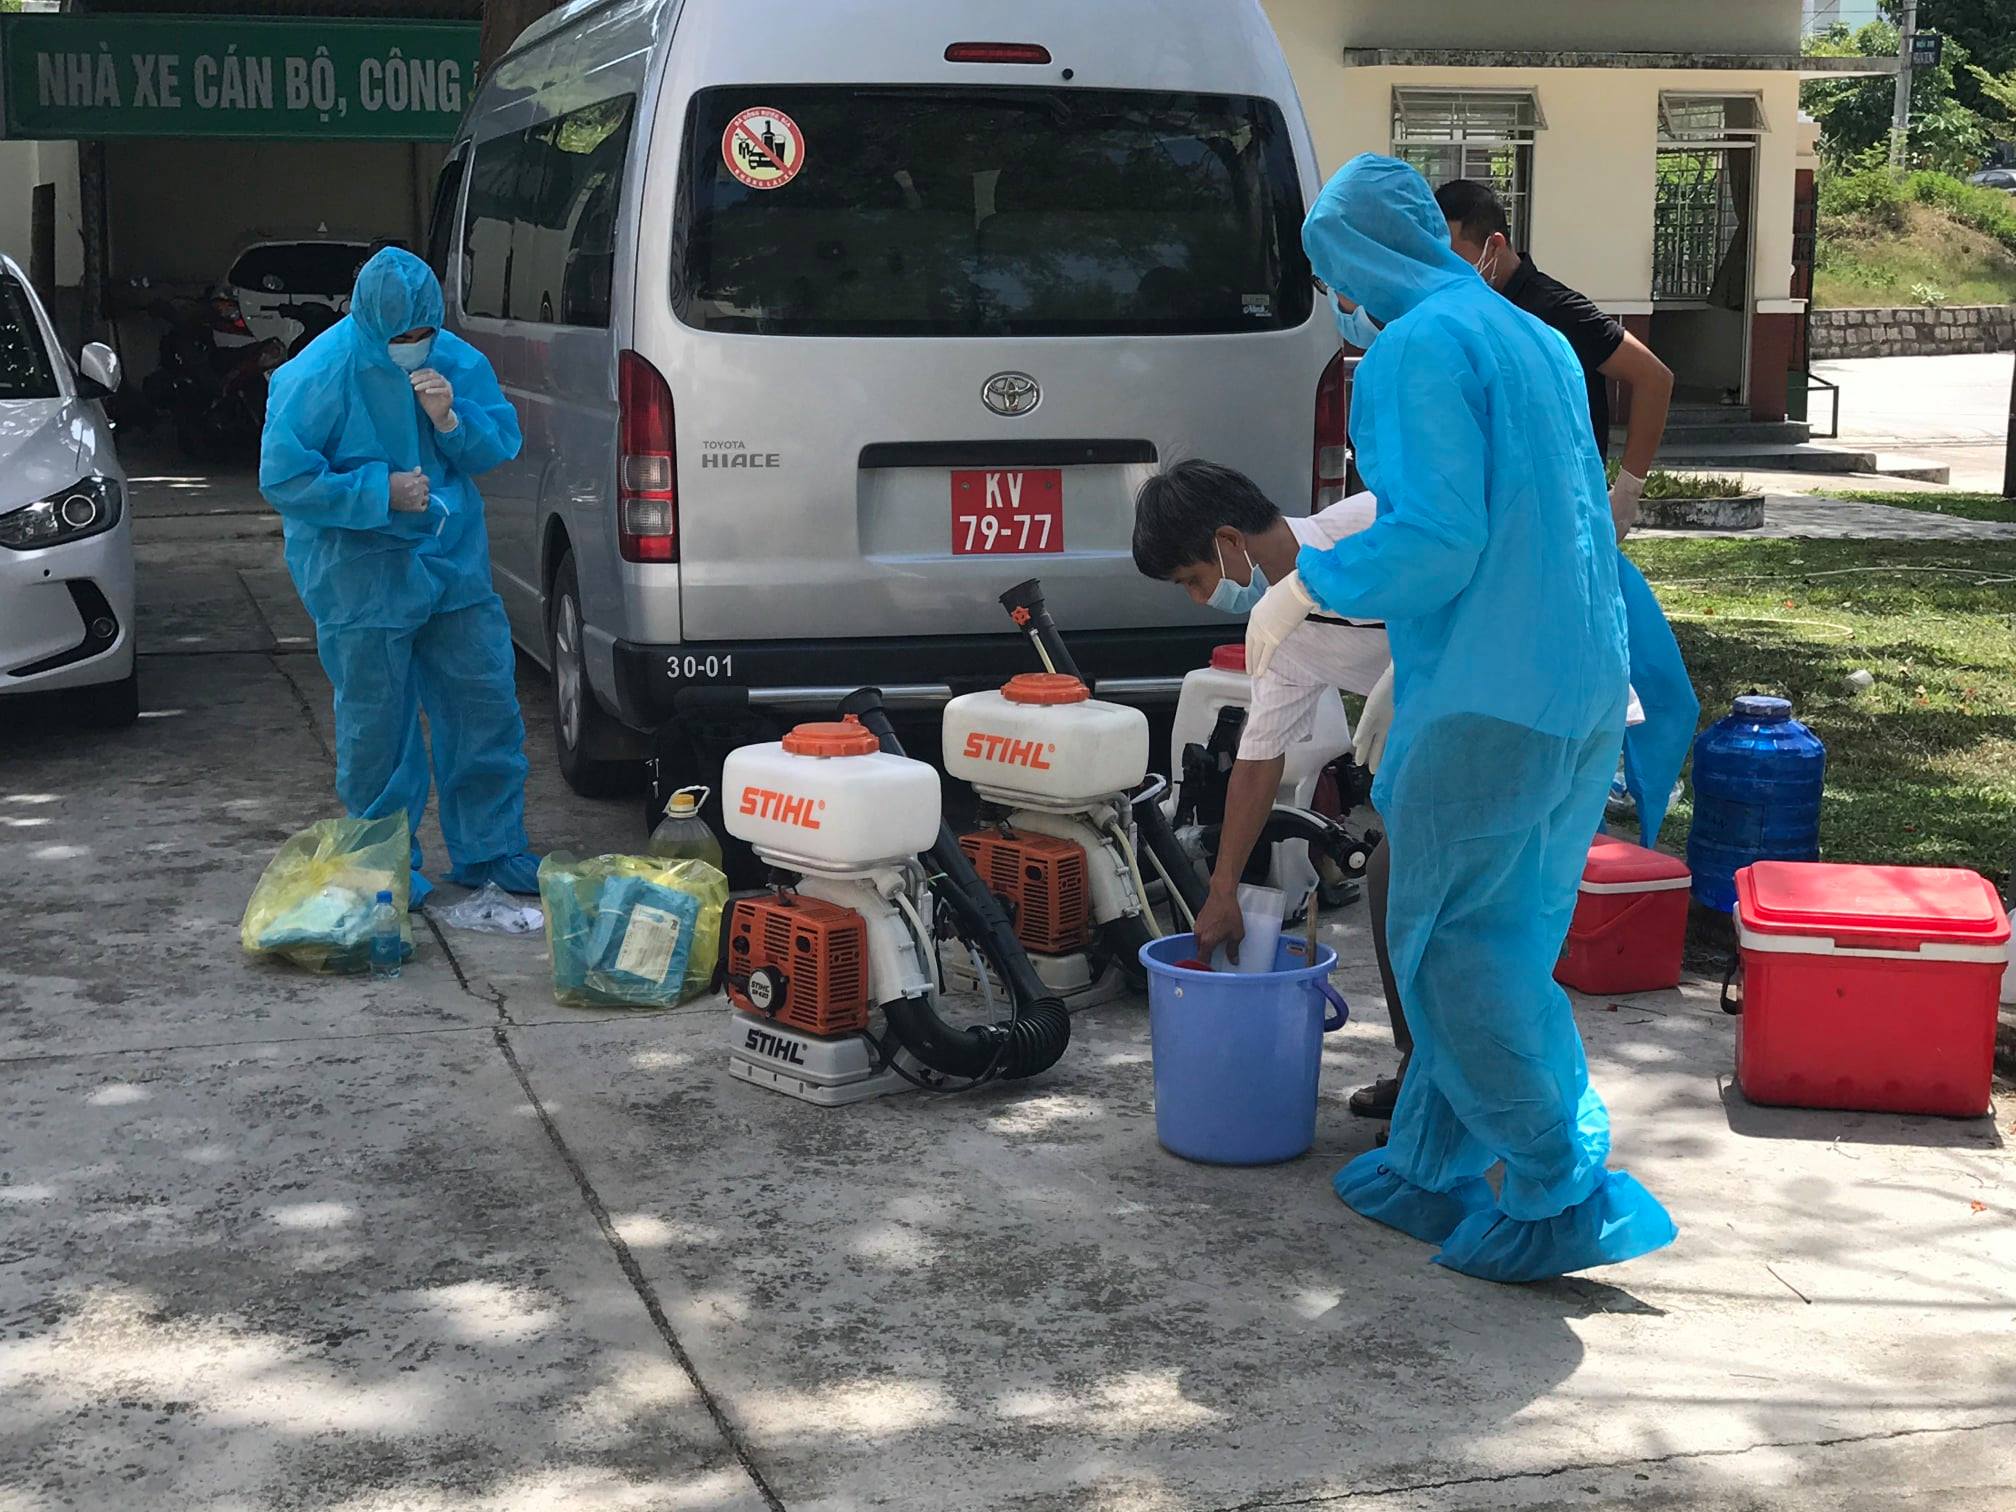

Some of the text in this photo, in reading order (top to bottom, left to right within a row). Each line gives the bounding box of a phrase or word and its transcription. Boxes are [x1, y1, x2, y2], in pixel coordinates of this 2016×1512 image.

[37, 41, 121, 107] NHÀ
[131, 53, 182, 108] XE
[193, 43, 274, 109] CÁN
[285, 45, 348, 122] BỘ,
[359, 46, 462, 113] CÔNG
[701, 453, 780, 468] HIACE
[702, 440, 746, 450] TOYOTA
[985, 472, 1024, 508] KV
[959, 514, 1052, 551] 79-77
[666, 654, 732, 678] 30-01
[962, 732, 1050, 770] STIHL
[739, 786, 821, 830] STIHL
[744, 1028, 805, 1066] STIHL
